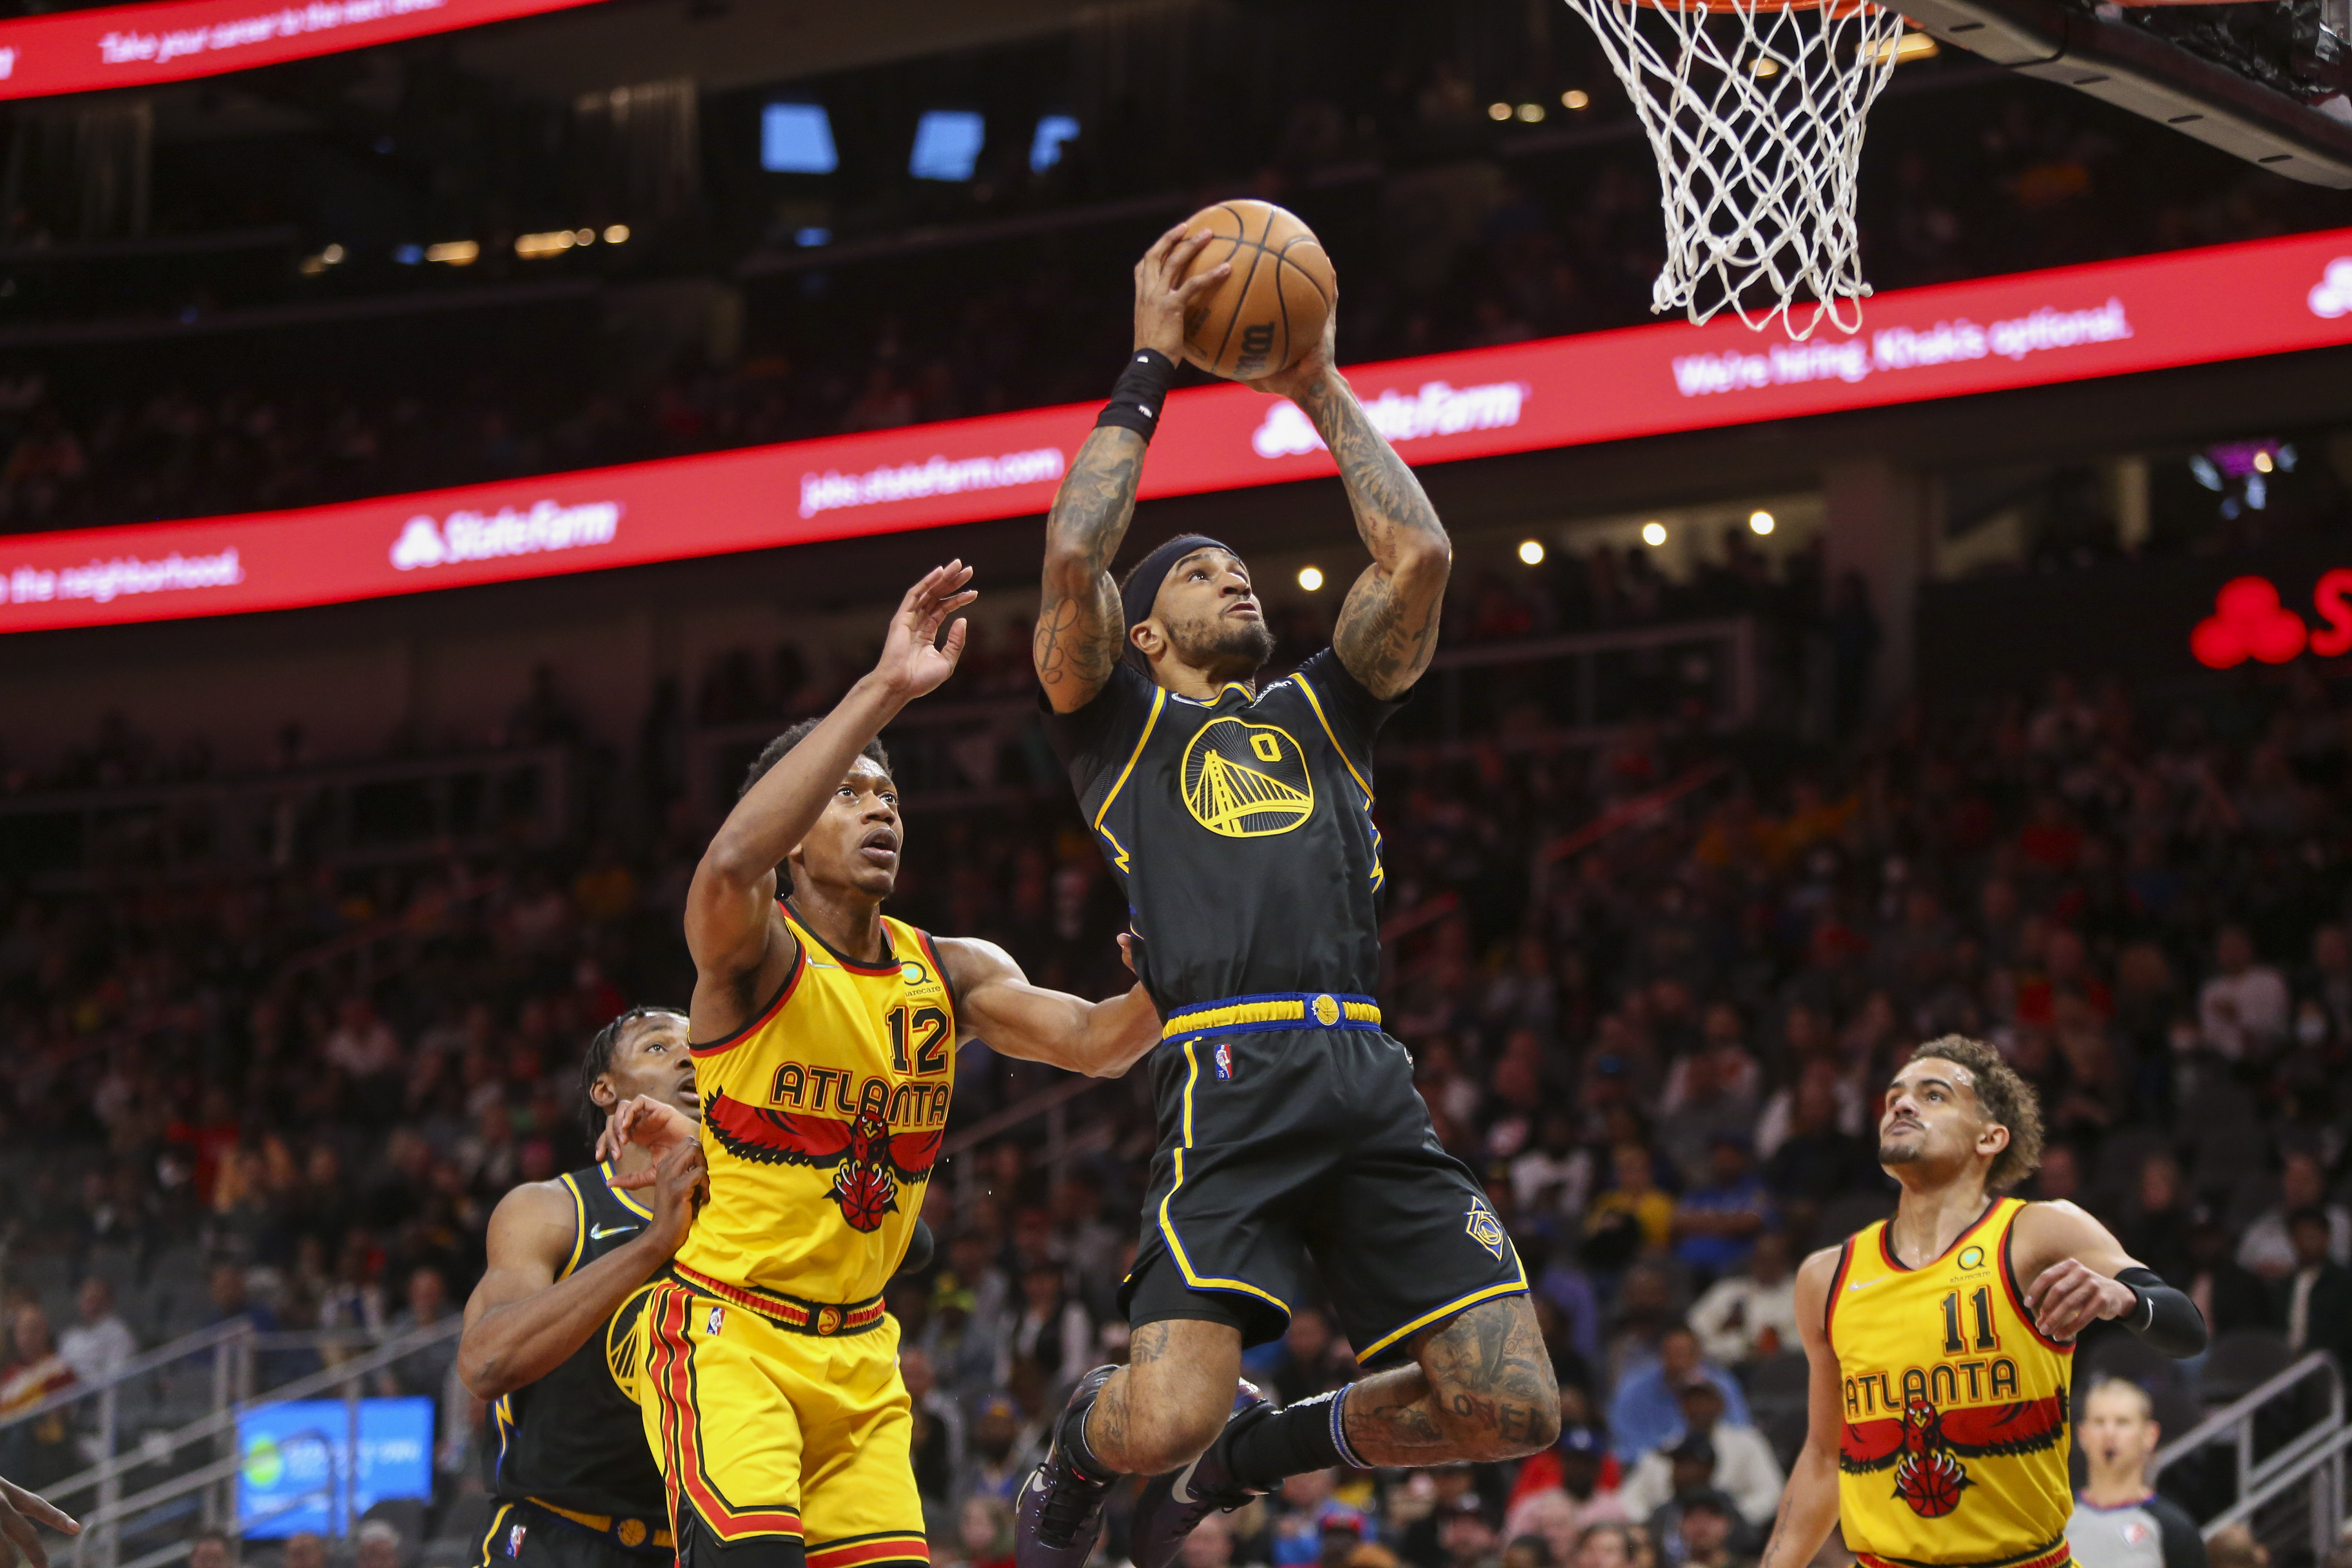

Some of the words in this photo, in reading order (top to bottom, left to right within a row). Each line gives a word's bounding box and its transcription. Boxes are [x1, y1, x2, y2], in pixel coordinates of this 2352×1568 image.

[98, 31, 159, 64] Take
[154, 26, 208, 64] your
[1672, 350, 1769, 397] We're
[1989, 296, 2134, 361] optional.
[798, 447, 1065, 519] jobs.statefarm.com
[1249, 733, 1283, 762] 0
[885, 1004, 951, 1077] 12
[769, 1061, 951, 1127] ATLANTA
[1950, 1270, 1991, 1284] sharecare
[1940, 1284, 2001, 1357] 11
[1845, 1355, 2021, 1420] ATLANTA
